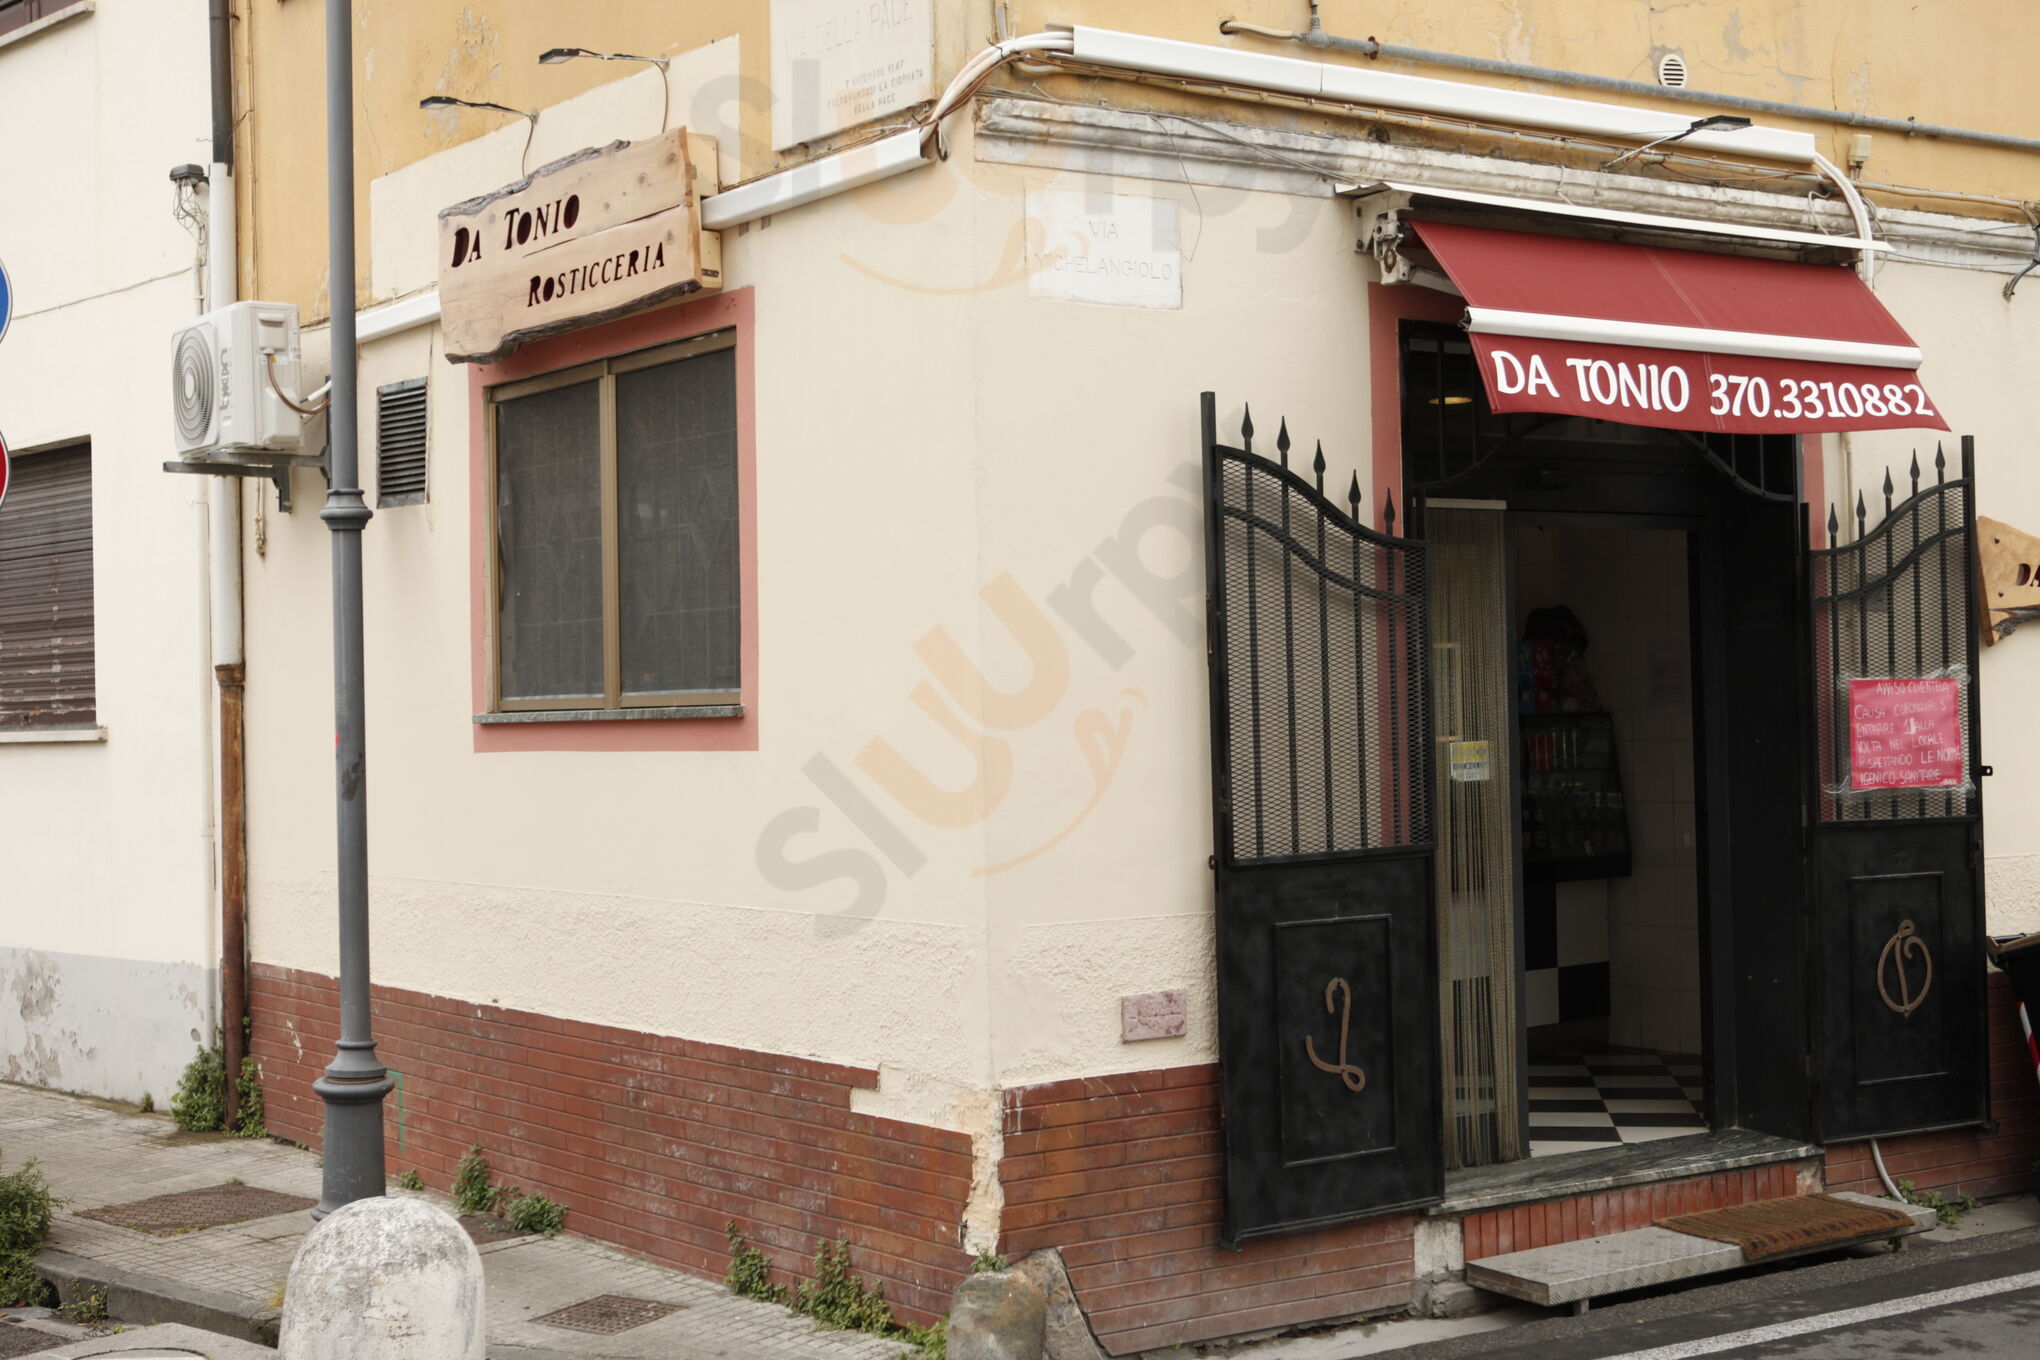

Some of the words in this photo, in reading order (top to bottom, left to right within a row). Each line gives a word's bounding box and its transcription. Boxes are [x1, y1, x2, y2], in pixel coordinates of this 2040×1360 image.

[870, 0, 913, 36] PACE
[878, 92, 896, 106] PACE
[451, 226, 482, 268] DA
[504, 194, 580, 251] TONIO
[1088, 221, 1120, 239] VIA
[527, 241, 665, 308] ROSTICCERIA
[1034, 253, 1173, 281] MICHELANGIOLO
[1491, 350, 1560, 398] DA
[1566, 357, 1689, 413] TONIO
[1710, 373, 1935, 419] 370.3310882
[1854, 704, 1886, 720] CAUSA
[1856, 722, 1895, 738] ENTRARE
[1856, 740, 1882, 754] VOLTA
[1921, 751, 1935, 764] LE
